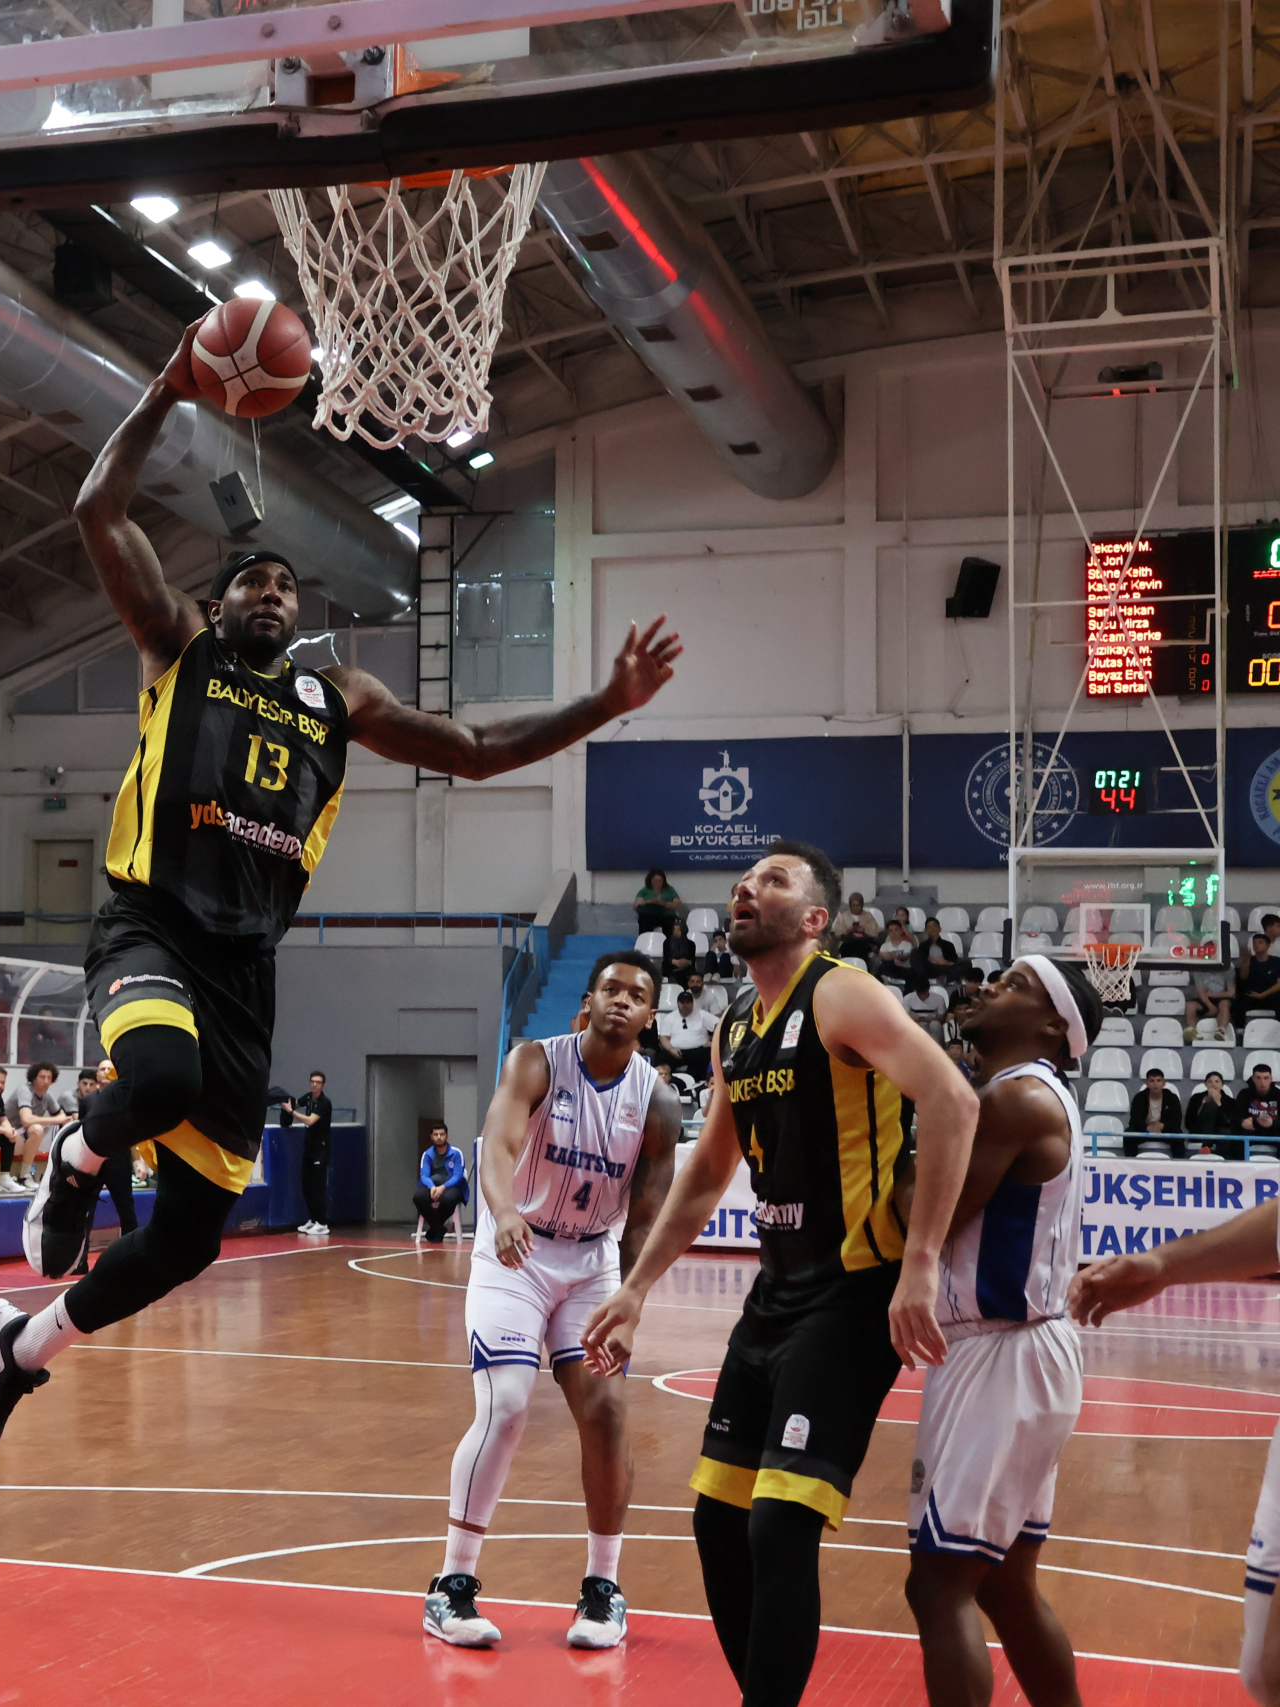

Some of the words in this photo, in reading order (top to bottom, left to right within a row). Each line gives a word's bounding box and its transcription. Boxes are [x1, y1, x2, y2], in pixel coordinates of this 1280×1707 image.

[1131, 578, 1162, 590] Kevin
[1088, 671, 1123, 683] Beyaz
[244, 733, 290, 792] 13
[572, 1180, 595, 1212] 4
